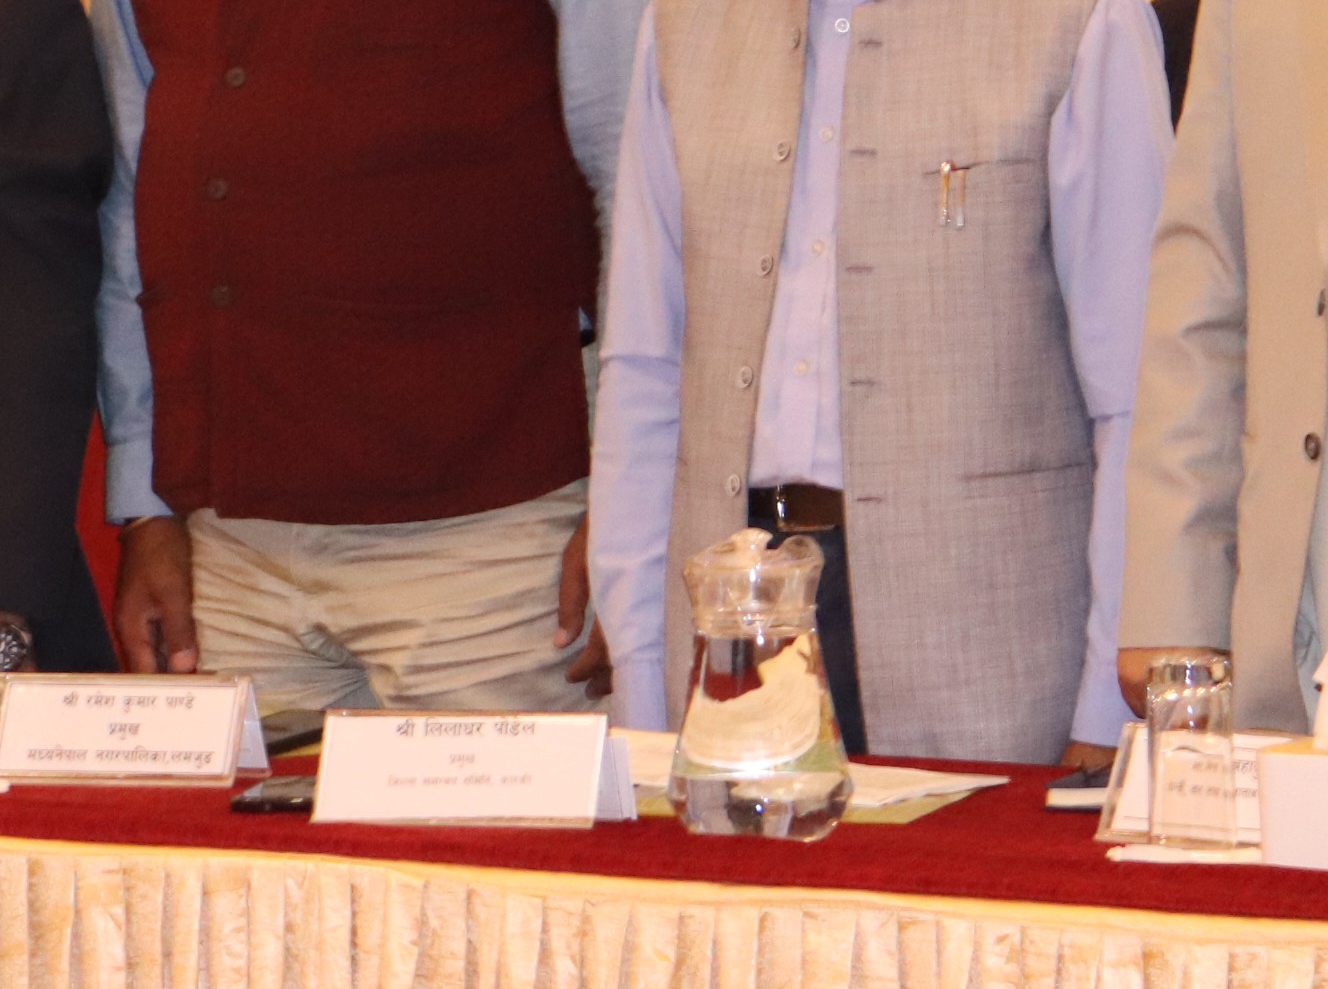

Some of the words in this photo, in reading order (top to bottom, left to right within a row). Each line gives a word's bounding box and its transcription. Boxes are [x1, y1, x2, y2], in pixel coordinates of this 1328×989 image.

[63, 691, 78, 708] श्री
[86, 691, 115, 707] रमेश
[123, 695, 158, 713] कुमार
[166, 692, 195, 709] पाण्डे
[108, 723, 140, 740] प्रमुख
[396, 718, 415, 737] श्री
[27, 745, 88, 761] मध्यनेपाल
[449, 753, 476, 768] प्रमुख
